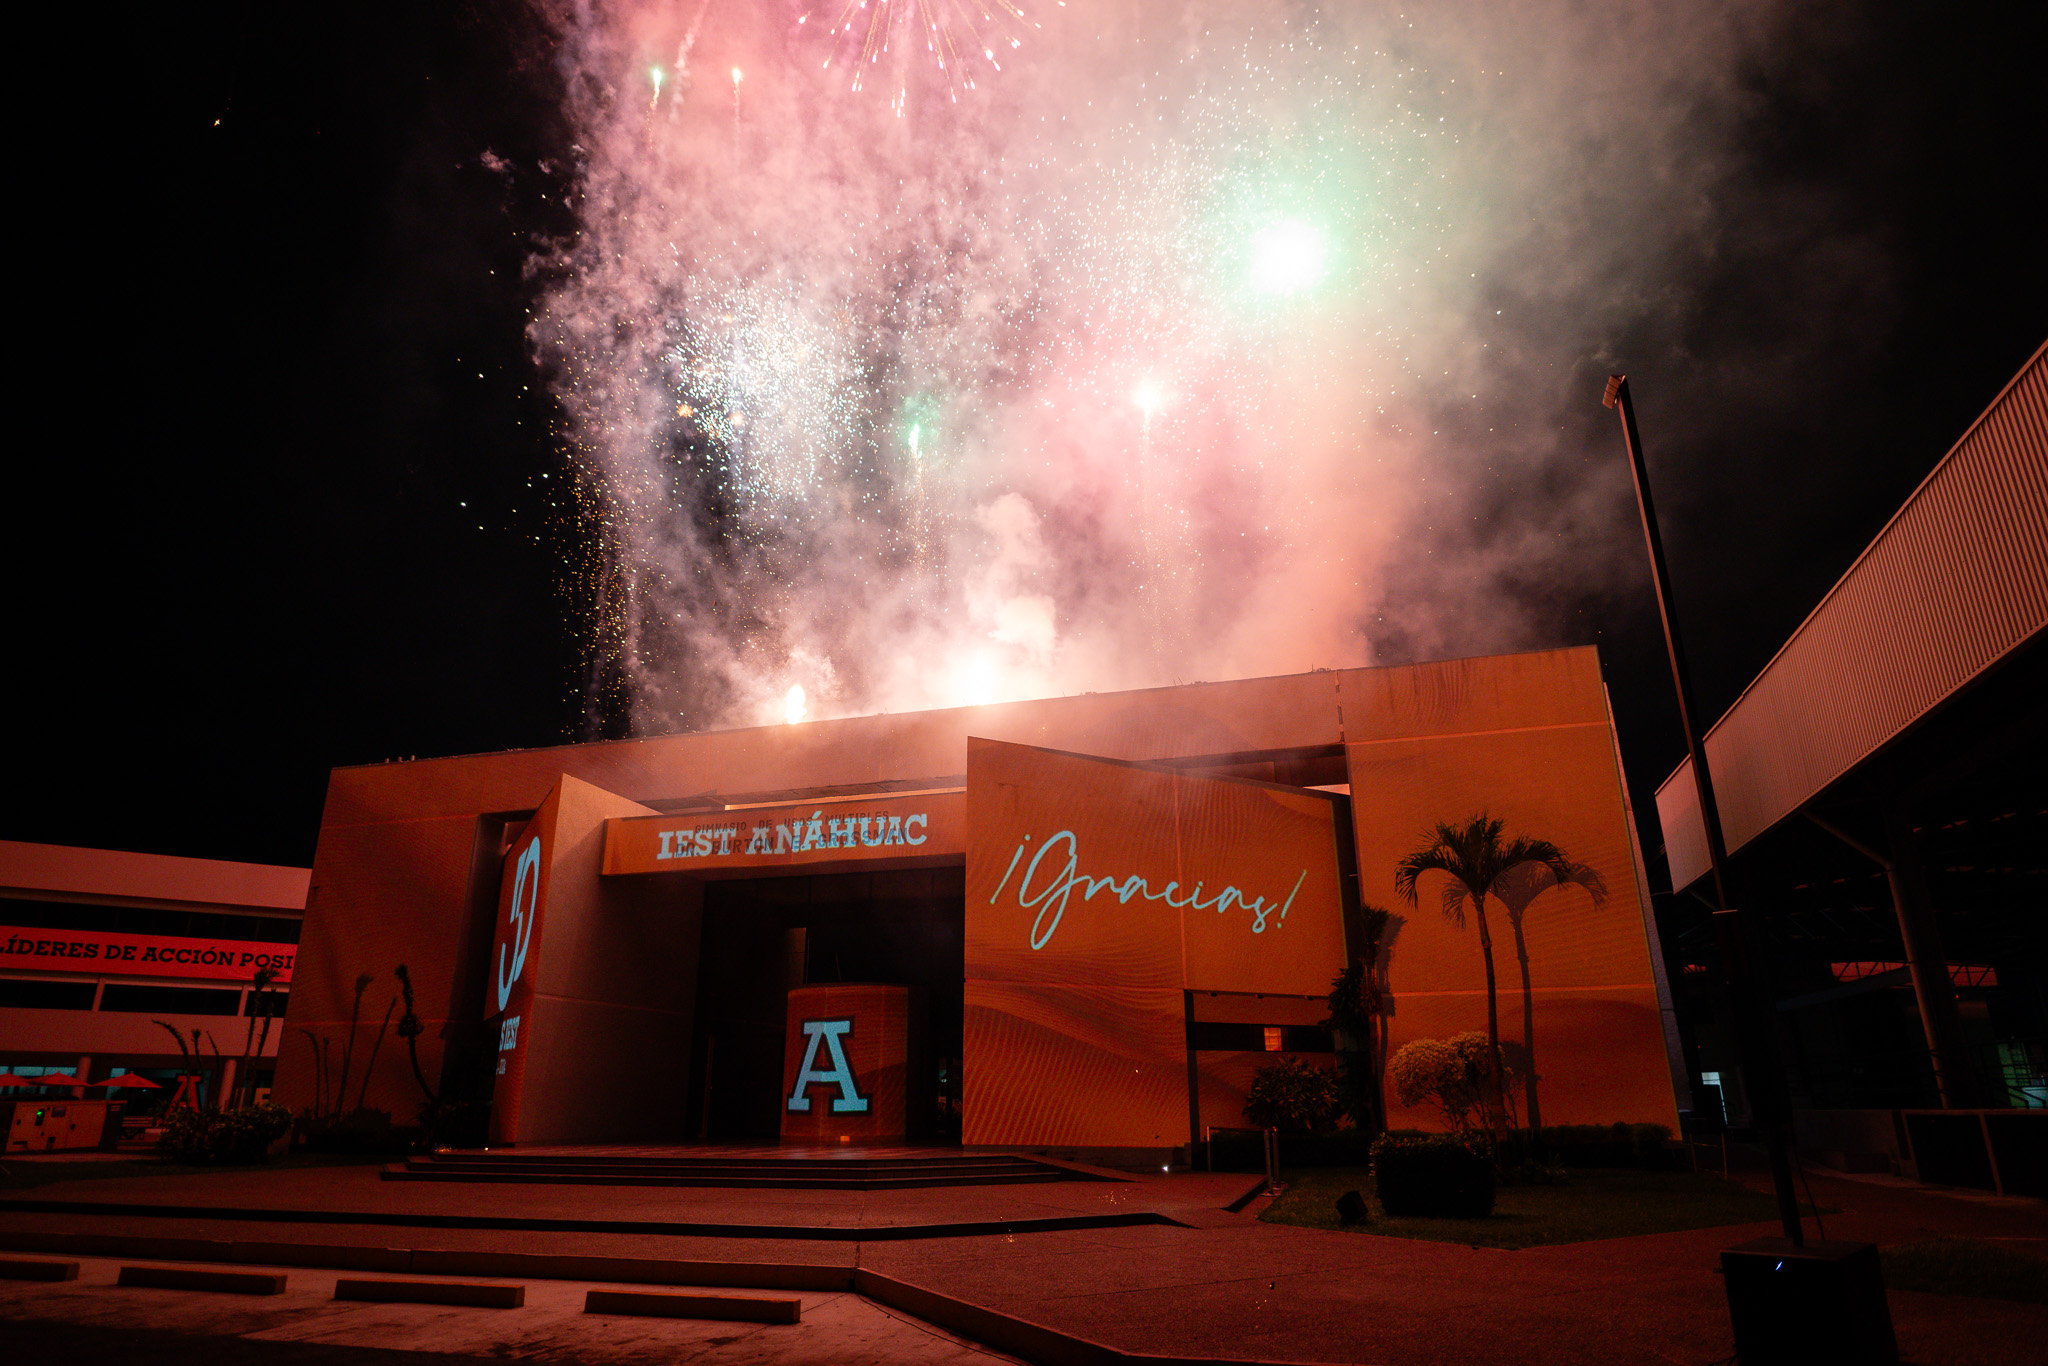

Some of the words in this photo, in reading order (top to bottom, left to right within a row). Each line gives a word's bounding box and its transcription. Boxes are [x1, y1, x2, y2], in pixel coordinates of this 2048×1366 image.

[656, 828, 736, 860] IEST
[744, 811, 928, 855] ANÁHUAC
[695, 821, 747, 834] GIMNASIO
[758, 820, 772, 830] DE
[784, 816, 813, 828] USOS
[825, 811, 889, 825] MULTIPLES
[711, 837, 774, 855] BURTON
[817, 827, 908, 848] GROSSMAN
[989, 830, 1307, 950] ¡Gracias!
[0, 934, 99, 959] ÍDERES
[104, 944, 137, 961] DE
[141, 946, 235, 967] ACCIÓN
[239, 952, 295, 970] POSI
[788, 1020, 868, 1112] A
